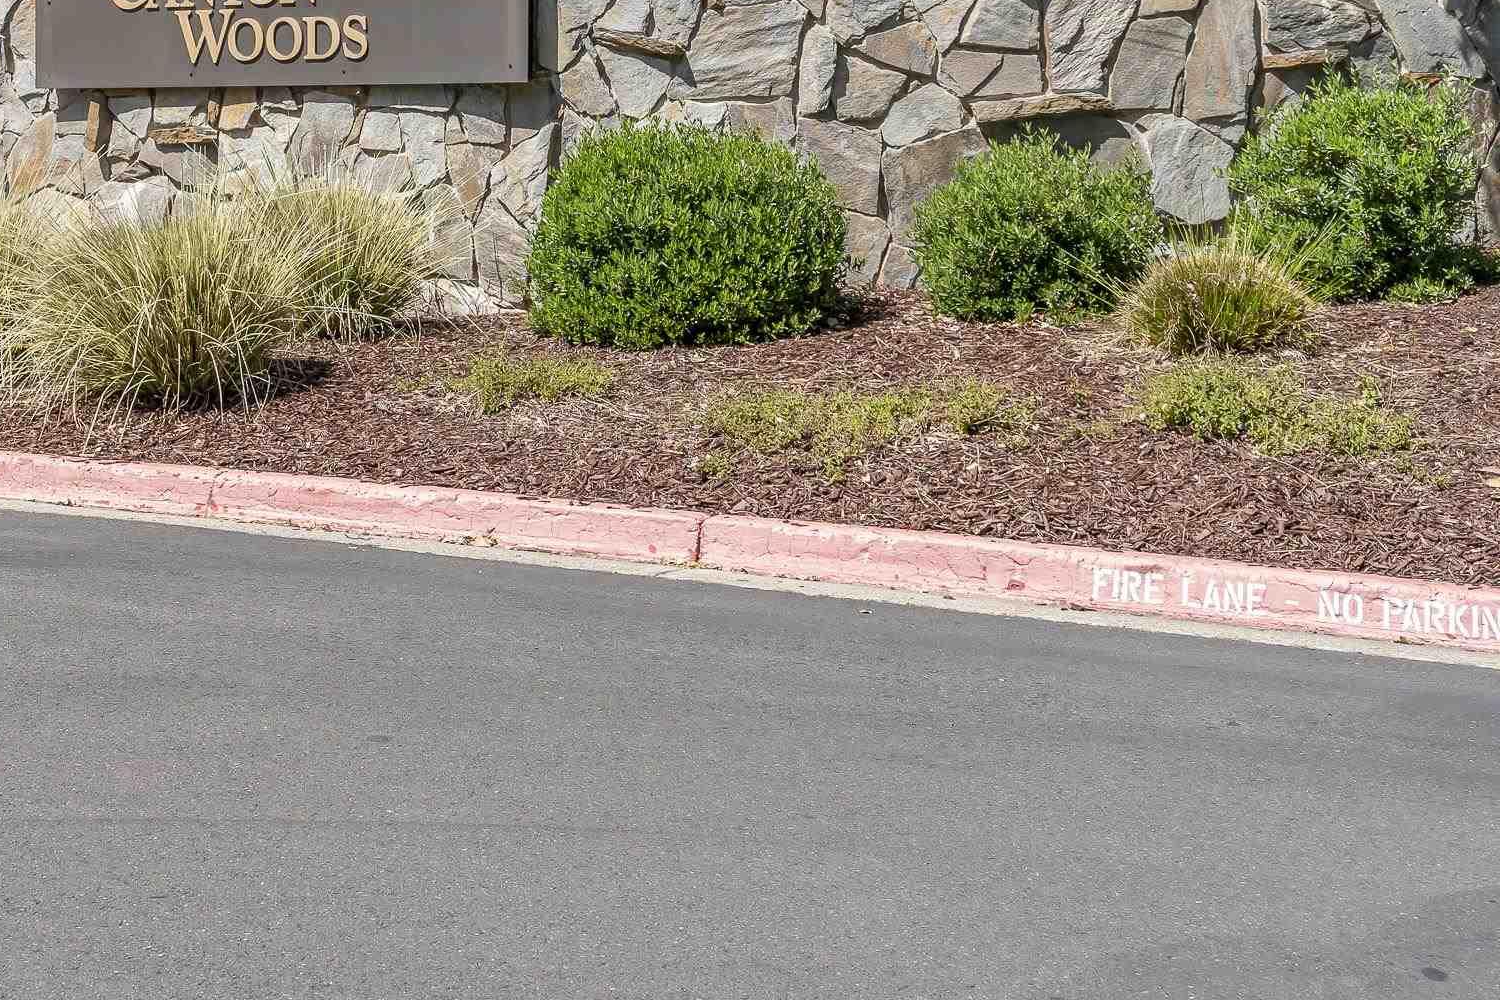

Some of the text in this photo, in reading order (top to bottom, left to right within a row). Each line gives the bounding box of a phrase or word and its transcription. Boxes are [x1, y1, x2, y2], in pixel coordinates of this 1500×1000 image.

[175, 9, 370, 65] WOODS
[1092, 567, 1165, 604] FIRE
[1178, 572, 1269, 617] LANE
[1316, 588, 1364, 625] NO
